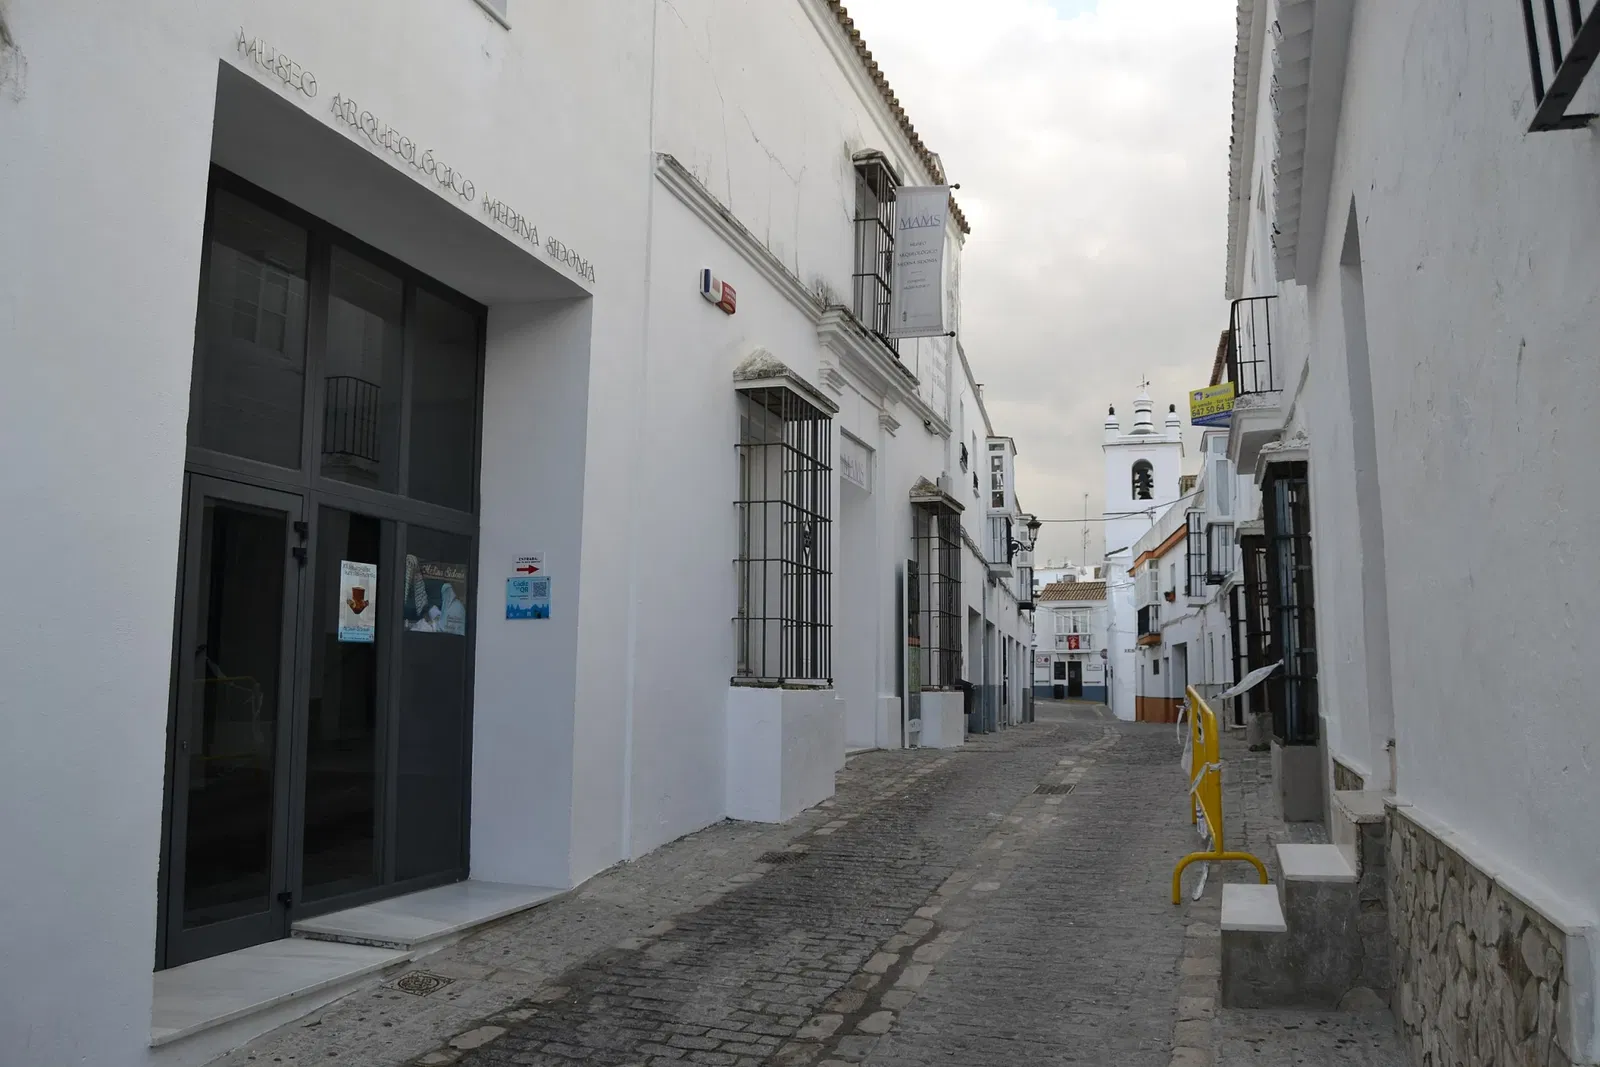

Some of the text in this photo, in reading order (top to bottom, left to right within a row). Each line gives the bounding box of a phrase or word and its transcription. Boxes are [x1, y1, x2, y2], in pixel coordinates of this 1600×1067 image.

[236, 26, 596, 283] MUSEO ARQUEOLÓGICO MEDINA SIDONIA
[899, 215, 941, 230] MAMS
[1206, 405, 1215, 413] 50
[1216, 403, 1225, 411] 64
